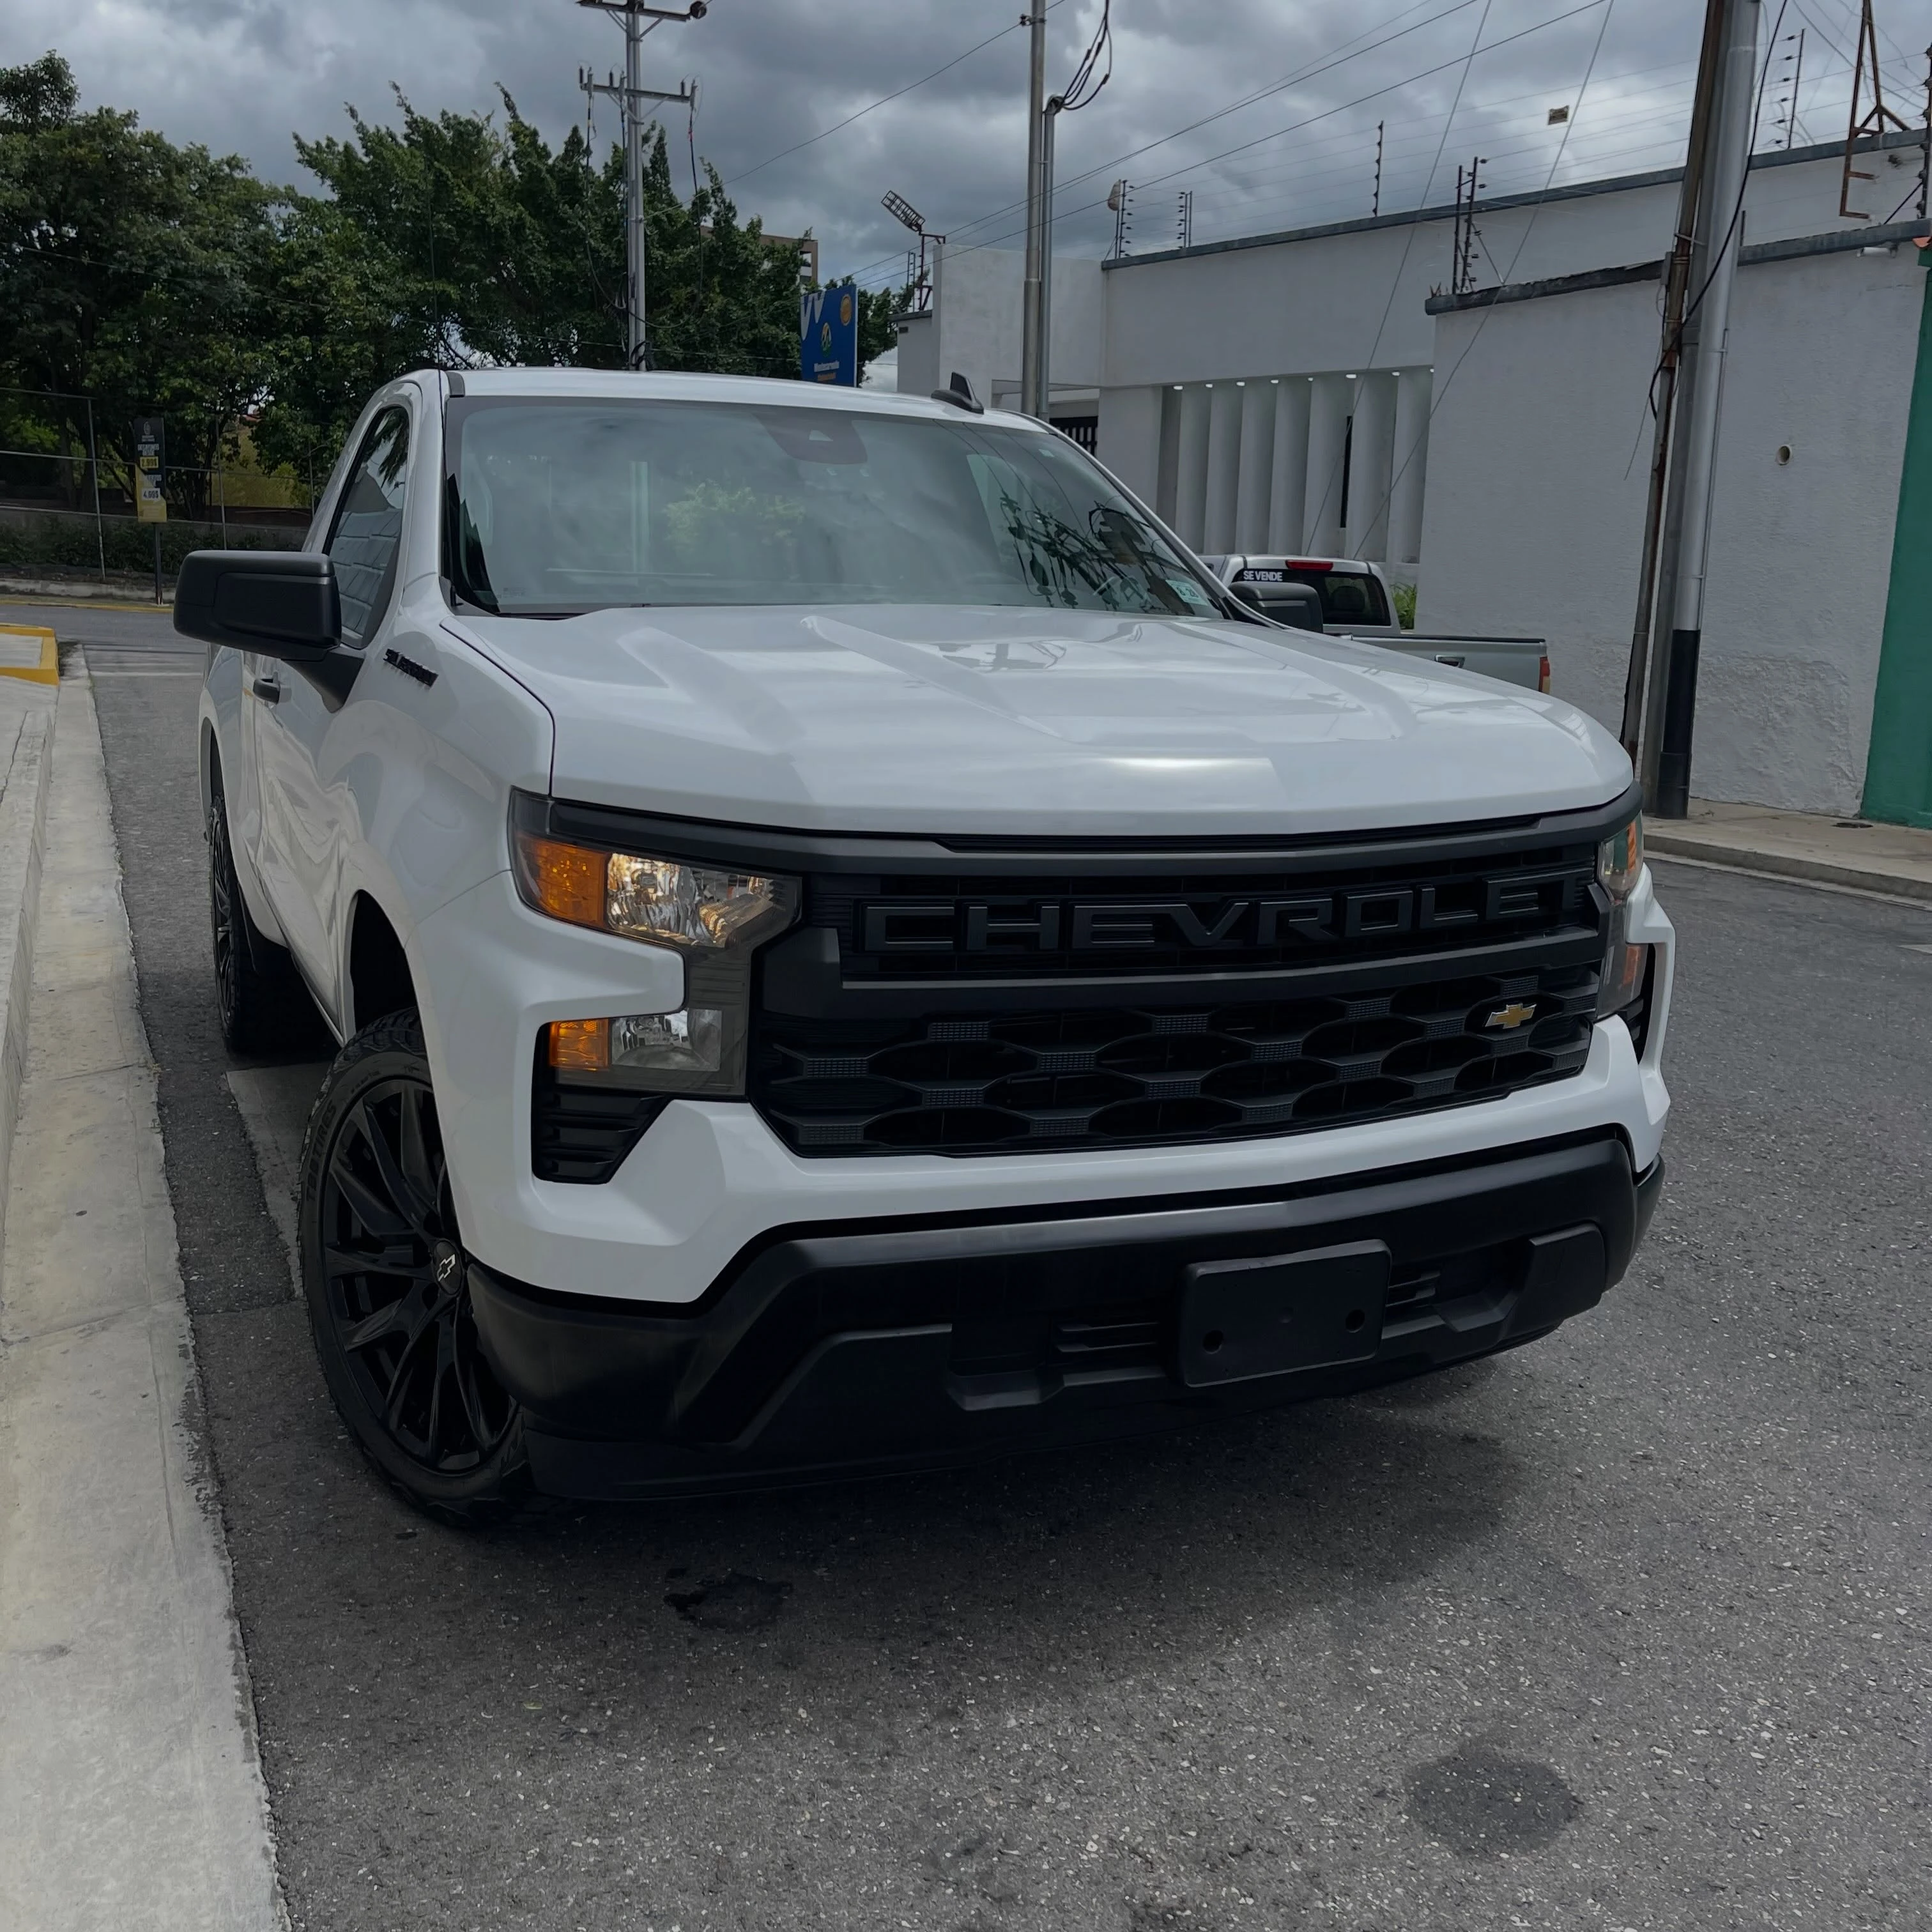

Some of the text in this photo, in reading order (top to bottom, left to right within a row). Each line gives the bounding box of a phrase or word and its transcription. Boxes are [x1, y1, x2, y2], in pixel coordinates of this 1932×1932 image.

[1243, 570, 1284, 582] SE VENDE
[862, 867, 1593, 951] CHEVROLET
